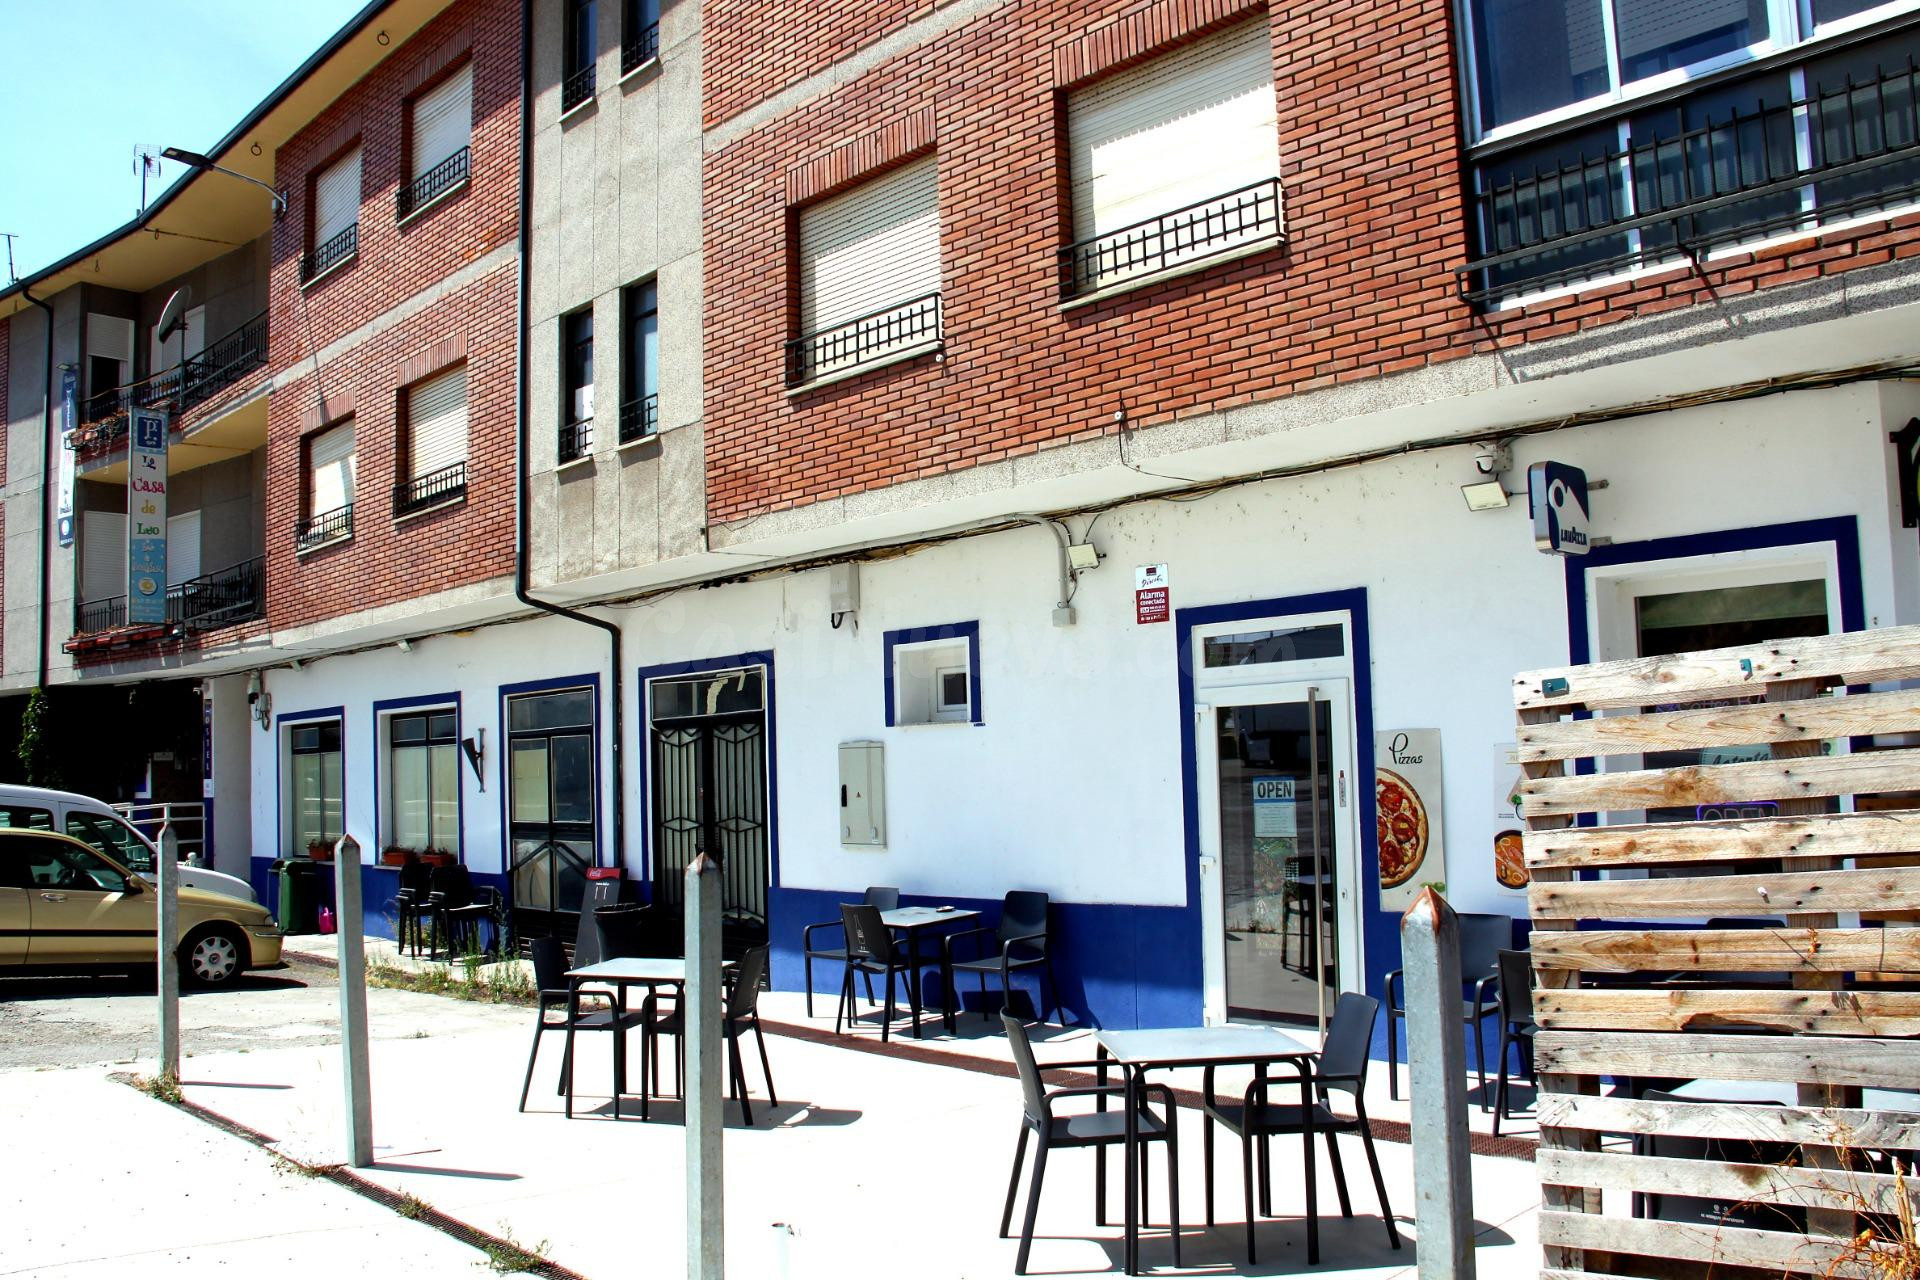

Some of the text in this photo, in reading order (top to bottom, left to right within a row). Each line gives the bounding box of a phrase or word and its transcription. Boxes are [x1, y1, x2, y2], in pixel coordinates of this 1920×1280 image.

[133, 477, 165, 494] Casa
[141, 499, 156, 514] de
[136, 522, 160, 535] Leo
[1140, 591, 1165, 600] Alarma
[1388, 732, 1423, 765] Pizzas
[1257, 781, 1292, 799] OPEN
